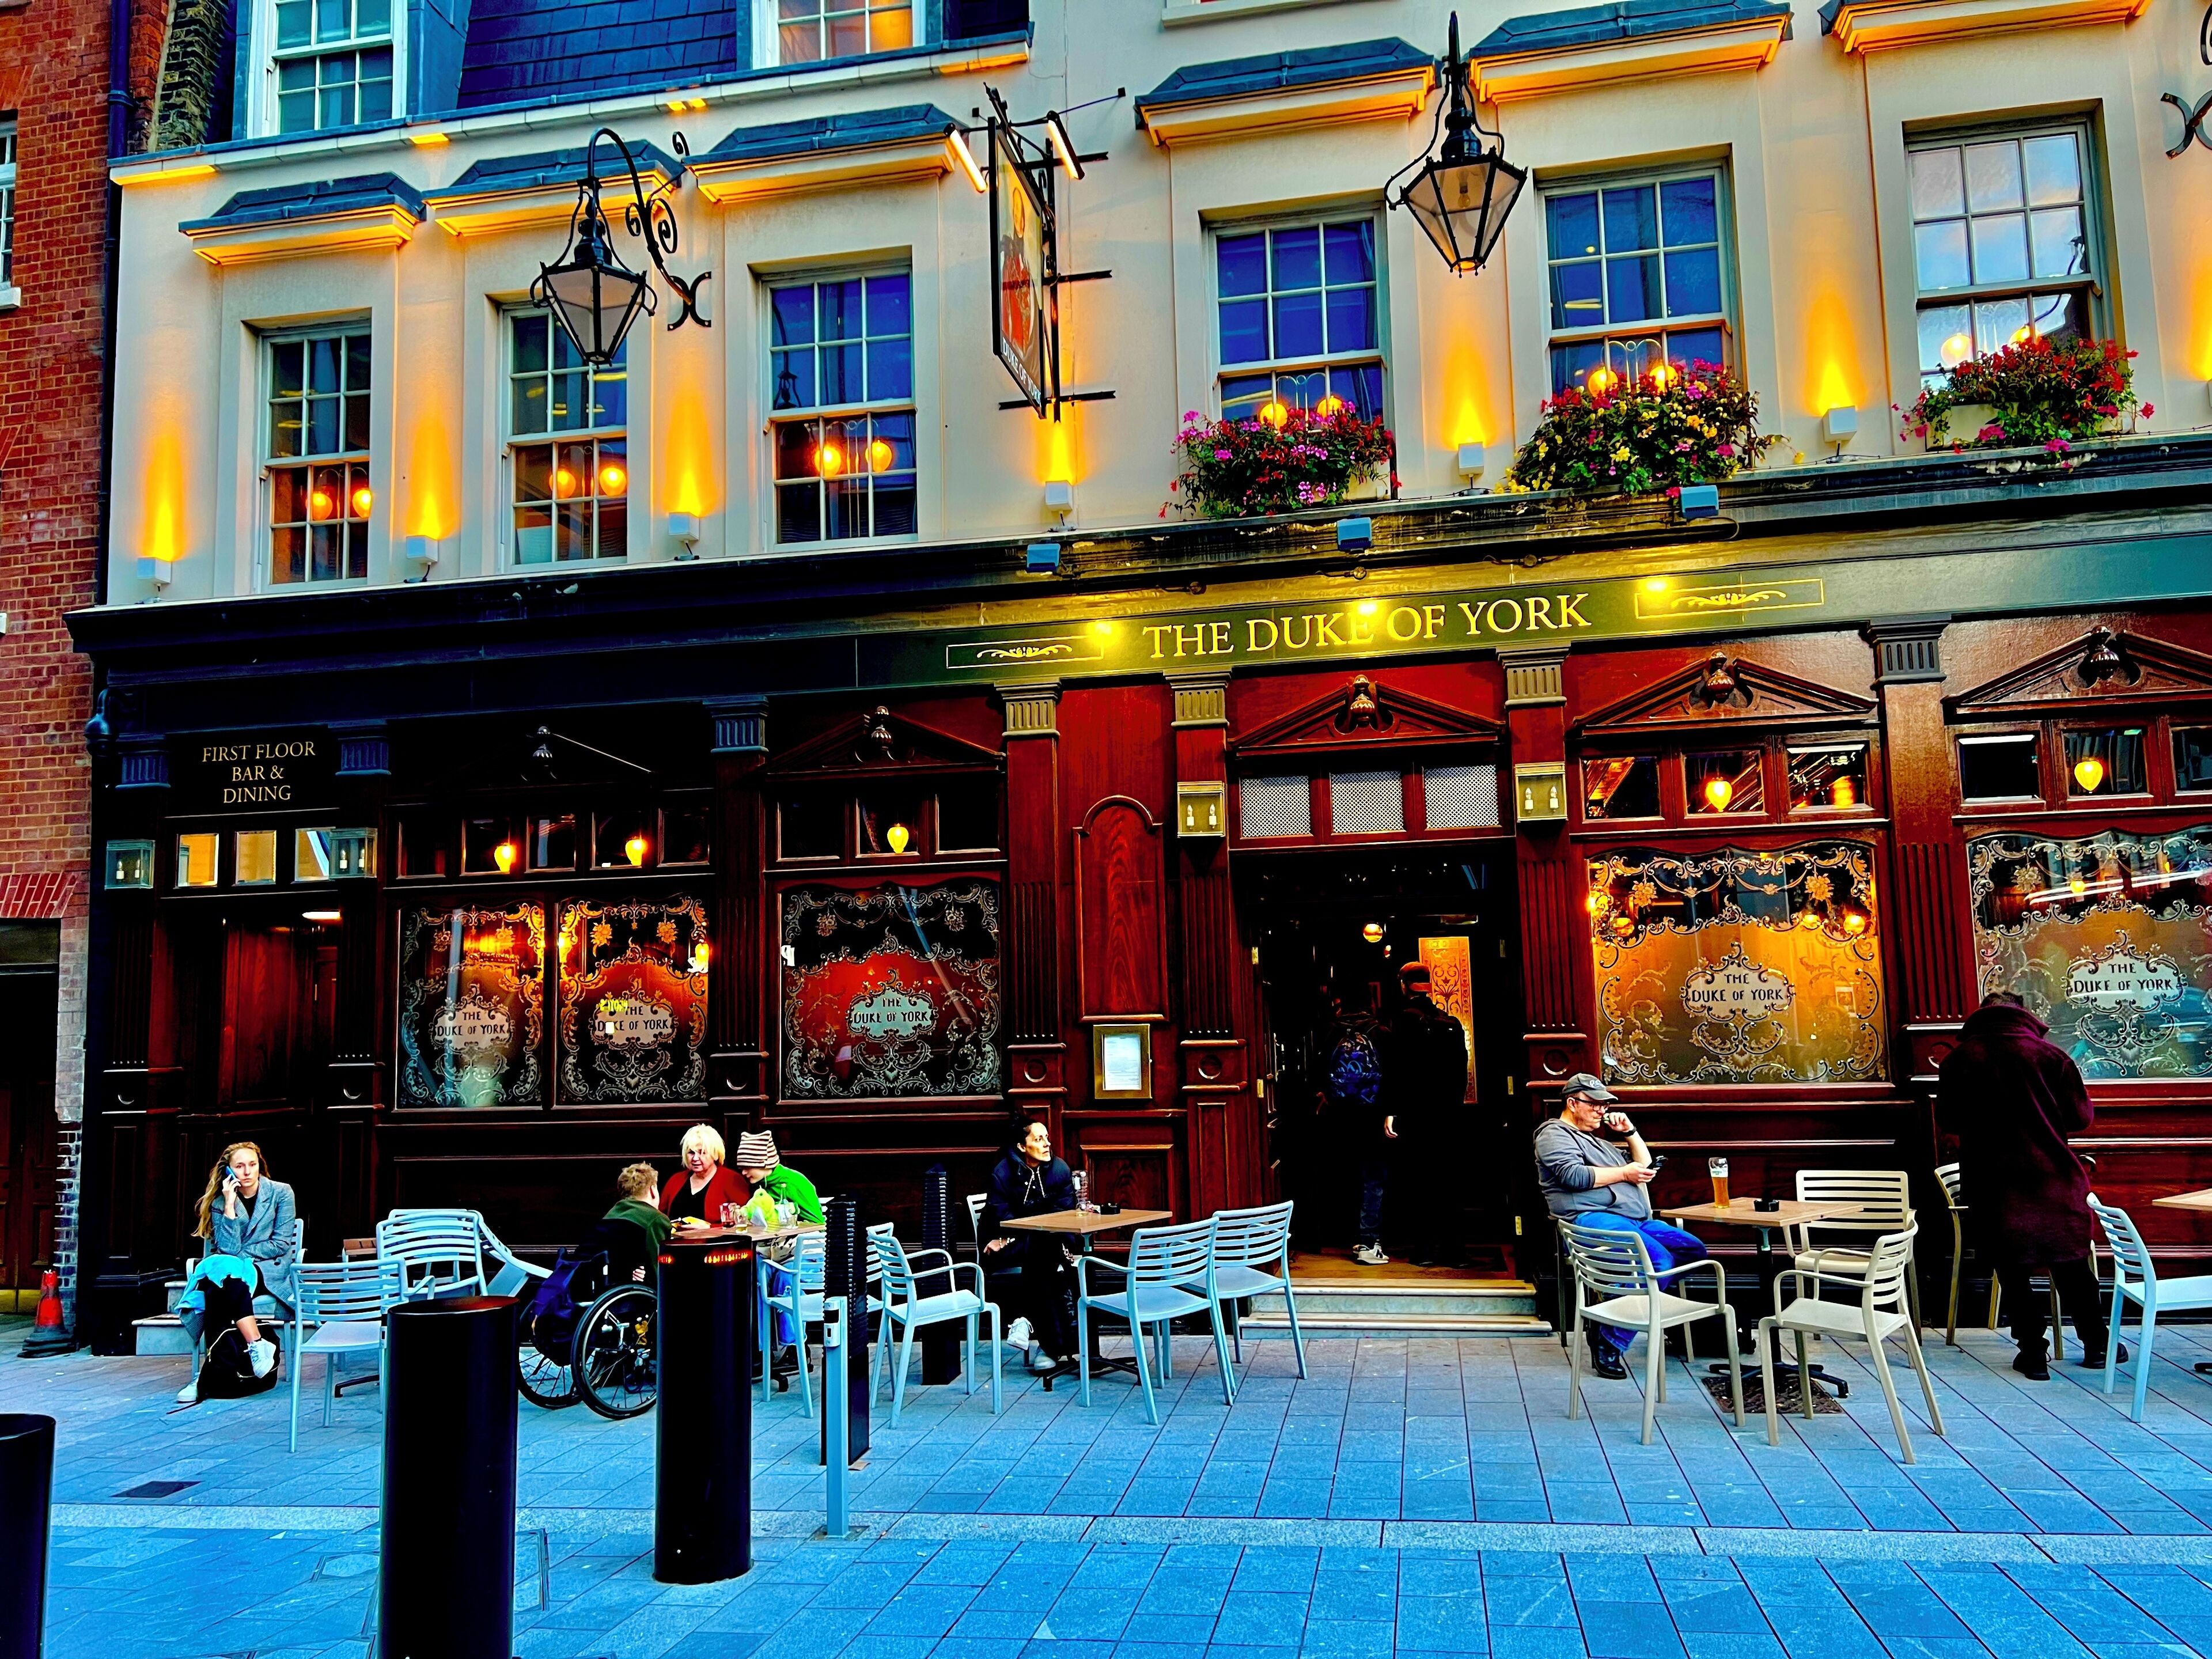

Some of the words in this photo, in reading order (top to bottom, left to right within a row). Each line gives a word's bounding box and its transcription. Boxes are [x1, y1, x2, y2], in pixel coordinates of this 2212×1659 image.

[1002, 336, 1019, 374] DUKE
[1019, 363, 1027, 385] OF
[1027, 373, 1041, 408] YORK
[1142, 622, 1234, 658] THE
[1246, 611, 1374, 652] DUKE
[1386, 604, 1445, 641] OF
[1457, 593, 1592, 635] YORK
[202, 745, 251, 762] FIRST
[255, 741, 316, 759] FLOOR
[232, 766, 266, 782] BAR
[270, 765, 285, 779] &
[223, 785, 291, 804] DINING
[2108, 963, 2137, 974] THE
[1724, 974, 1750, 984] THE
[2074, 980, 2111, 993] DUKE
[2118, 980, 2131, 991] OF
[2137, 979, 2173, 991] YORK
[881, 997, 902, 1007] THE
[1692, 989, 1726, 1002] DUKE
[1732, 990, 1744, 1001] OF
[1751, 989, 1783, 1001] YORK
[462, 1011, 481, 1021] THE
[625, 1006, 643, 1016] THE
[854, 1012, 882, 1024] DUKE
[887, 1012, 897, 1022] OF
[900, 1011, 929, 1022] YORK
[437, 1025, 463, 1036] DUKE
[467, 1025, 477, 1035] OF
[480, 1024, 505, 1035] YORK
[597, 1020, 624, 1032] DKE
[628, 1021, 639, 1031] OF
[643, 1019, 668, 1030] YORK
